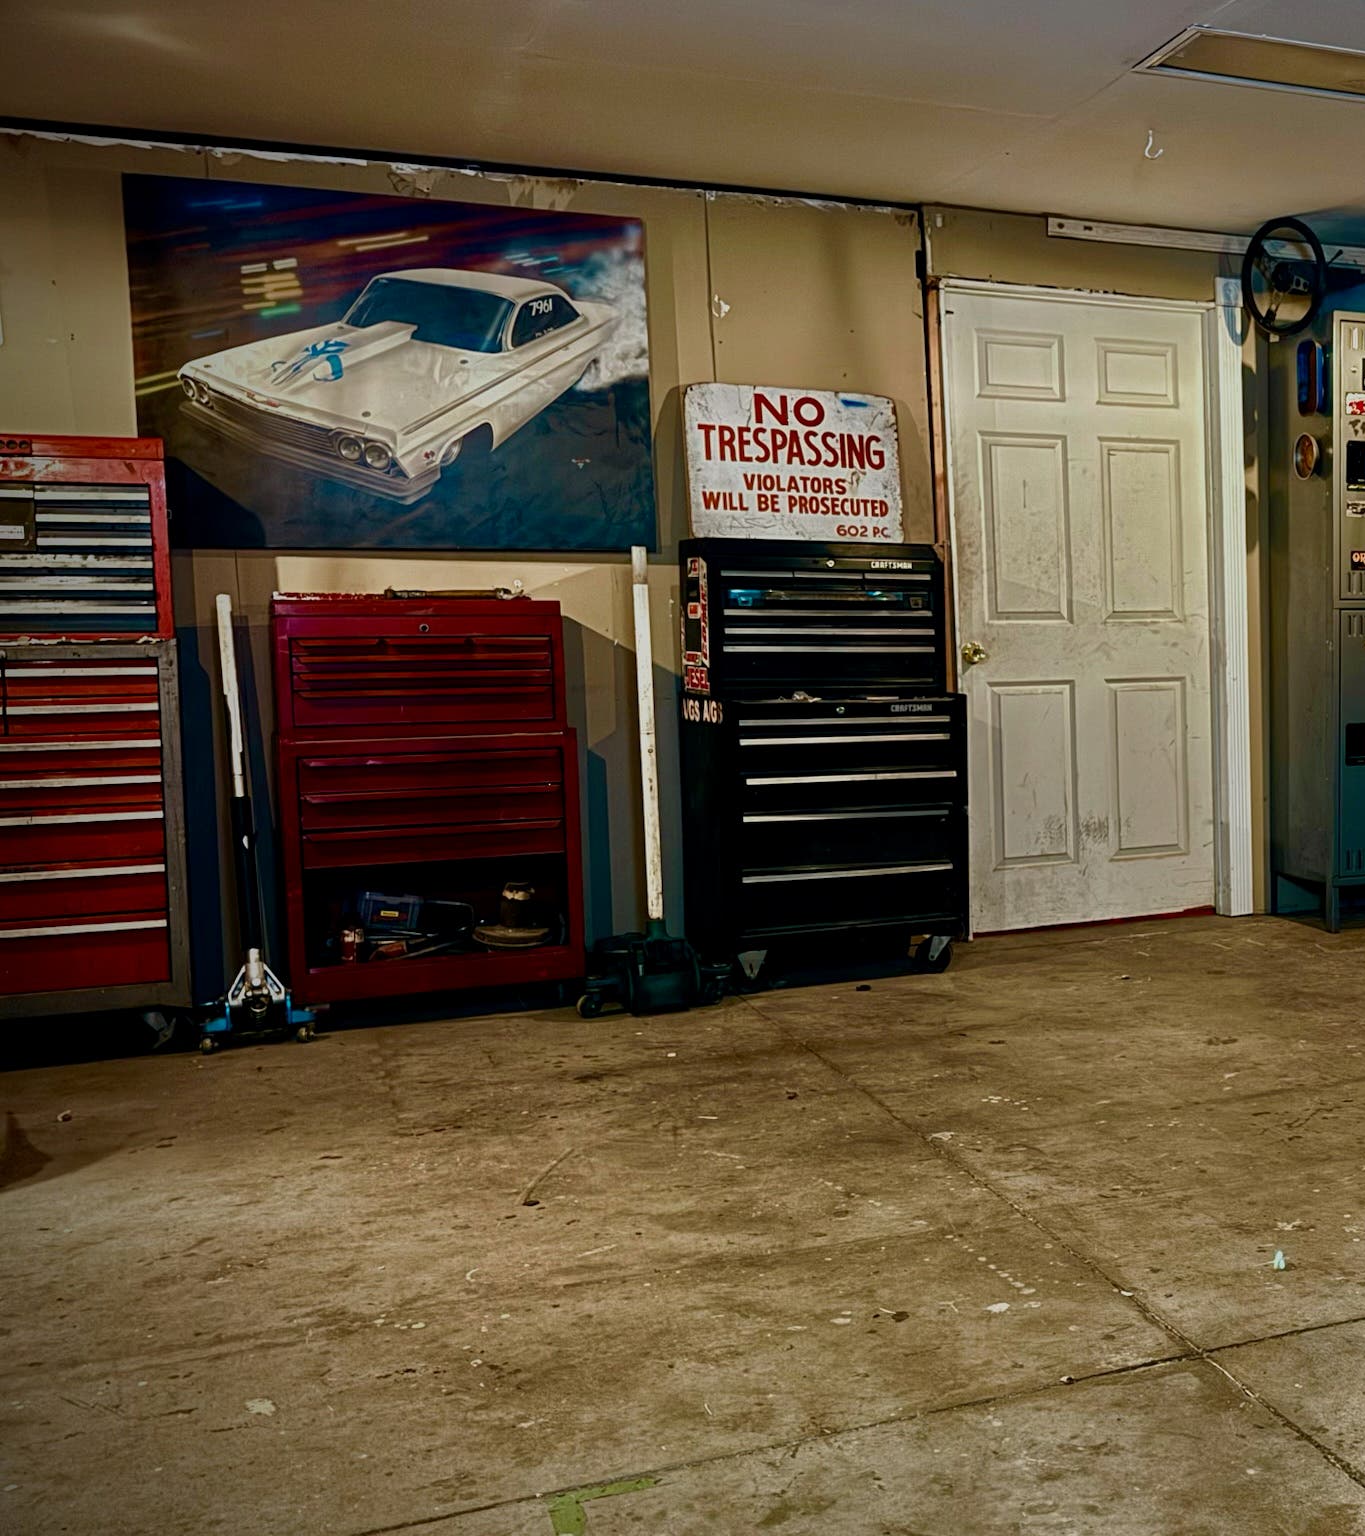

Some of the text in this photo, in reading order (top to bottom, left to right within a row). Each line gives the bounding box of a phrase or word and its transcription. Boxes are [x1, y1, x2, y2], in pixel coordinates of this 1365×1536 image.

[529, 298, 553, 316] 7961
[753, 393, 825, 427] NO
[697, 423, 886, 471] TRESPASSING
[743, 473, 847, 495] VIOLATORS
[702, 491, 889, 518] WILL BE PROSECUTED
[836, 525, 869, 538] 602
[870, 561, 913, 570] CRAFTSMAN
[890, 703, 933, 713] CRAFTSMAN
